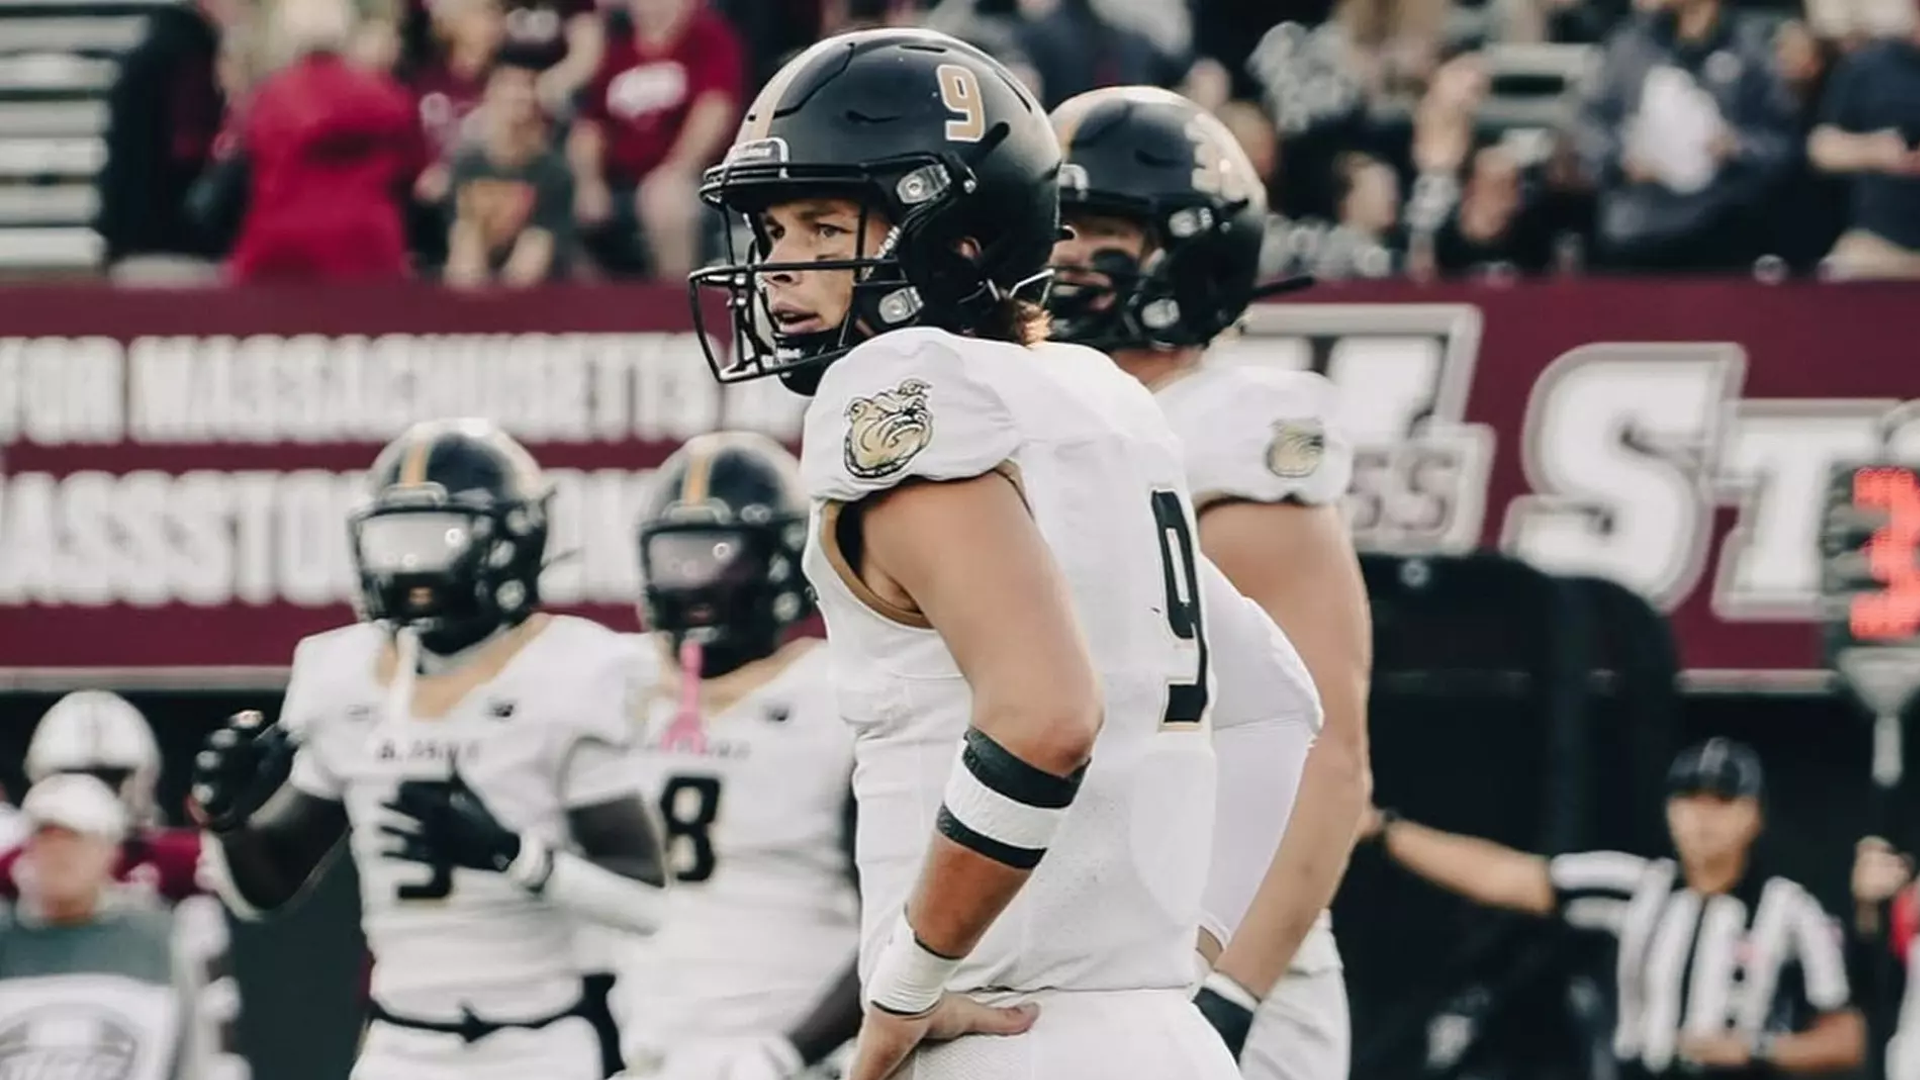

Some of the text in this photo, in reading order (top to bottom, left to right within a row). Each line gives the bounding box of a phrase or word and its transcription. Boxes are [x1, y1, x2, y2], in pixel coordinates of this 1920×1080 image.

[936, 64, 985, 142] 9
[0, 335, 124, 445] FOR
[129, 331, 724, 444] MASSACHUSETTS
[0, 468, 366, 608] ASSSTO
[1502, 342, 1920, 624] ST
[1150, 487, 1210, 724] 9
[660, 775, 721, 881] 8
